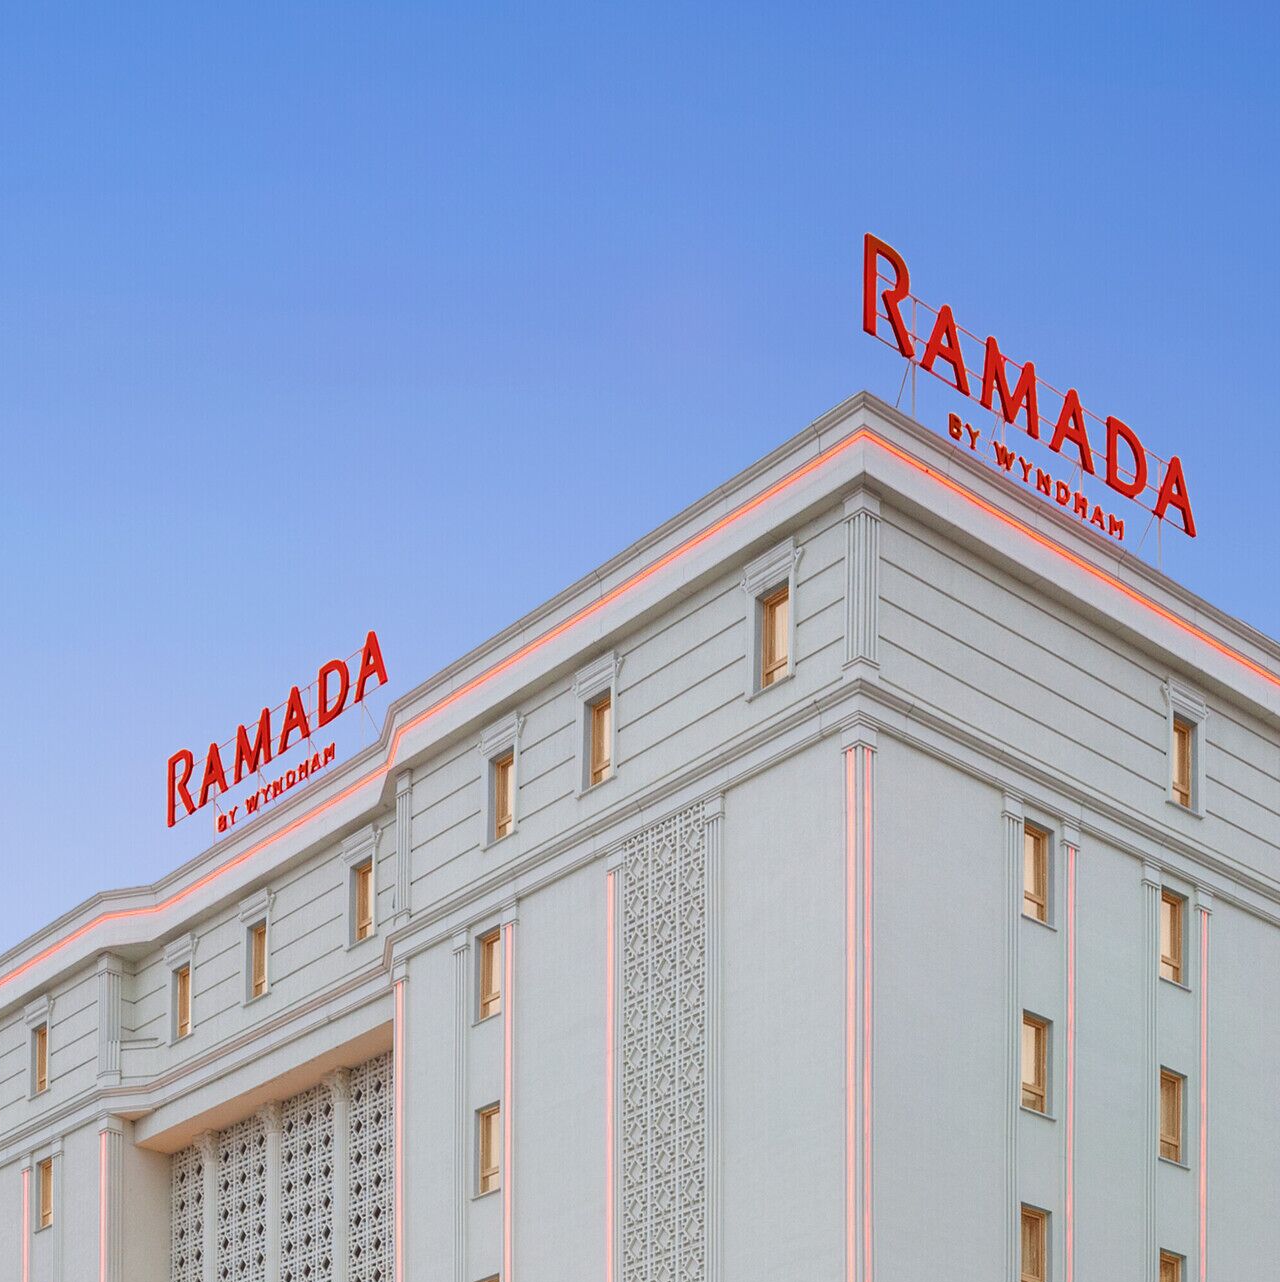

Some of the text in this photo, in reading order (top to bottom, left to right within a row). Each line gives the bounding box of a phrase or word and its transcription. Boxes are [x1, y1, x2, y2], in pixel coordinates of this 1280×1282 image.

[863, 232, 1197, 538] RAMADA
[948, 412, 1125, 540] BY WYNDHAM
[167, 630, 388, 828] RAMADA
[218, 742, 336, 833] BY WYNDHAM
